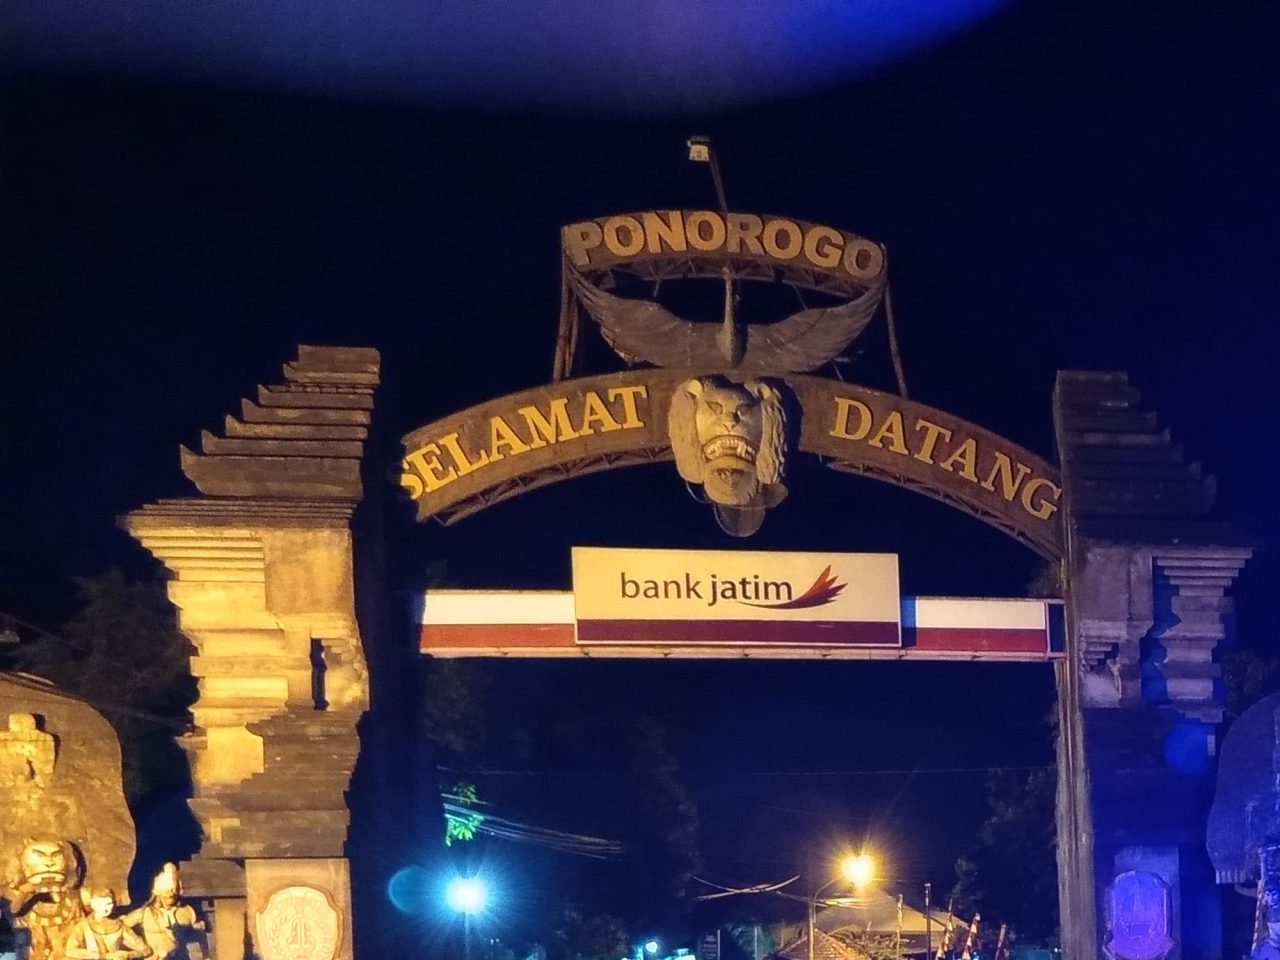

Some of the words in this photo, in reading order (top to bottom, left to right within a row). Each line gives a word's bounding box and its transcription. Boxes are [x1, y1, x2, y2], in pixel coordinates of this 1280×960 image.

[563, 209, 884, 278] PONOROGO
[401, 385, 648, 499] SELAMAT
[829, 397, 1063, 520] DATANG
[621, 571, 703, 600] bank
[708, 574, 793, 607] jatim
